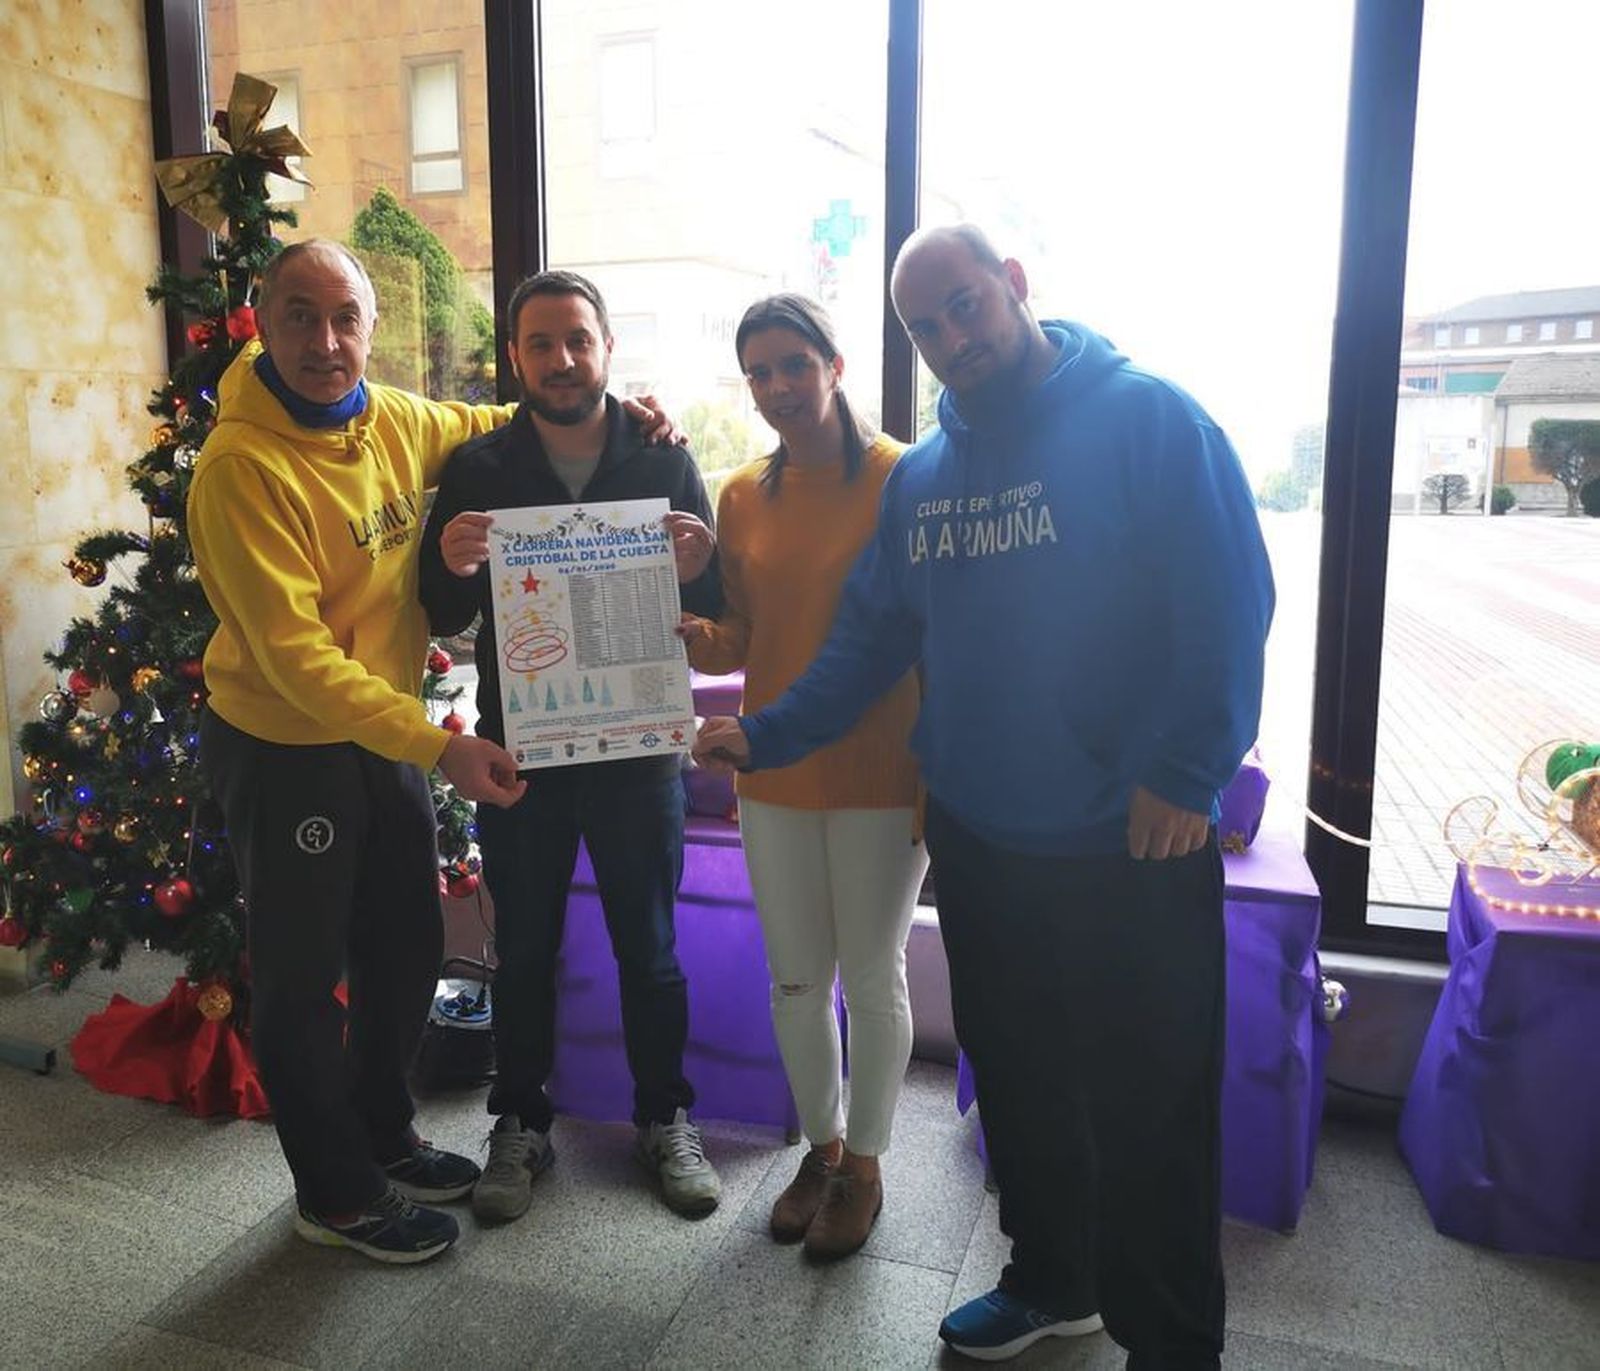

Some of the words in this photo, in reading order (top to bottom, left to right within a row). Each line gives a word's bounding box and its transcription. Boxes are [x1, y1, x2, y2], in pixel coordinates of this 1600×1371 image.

[917, 499, 951, 518] CLUB
[501, 542, 511, 554] X
[513, 538, 573, 553] CARRERA
[644, 530, 670, 544] SAN
[908, 525, 929, 565] LA
[505, 550, 578, 567] CRISTÓBAL
[580, 550, 597, 561] DE
[600, 549, 616, 560] LA
[618, 543, 669, 558] CUESTA
